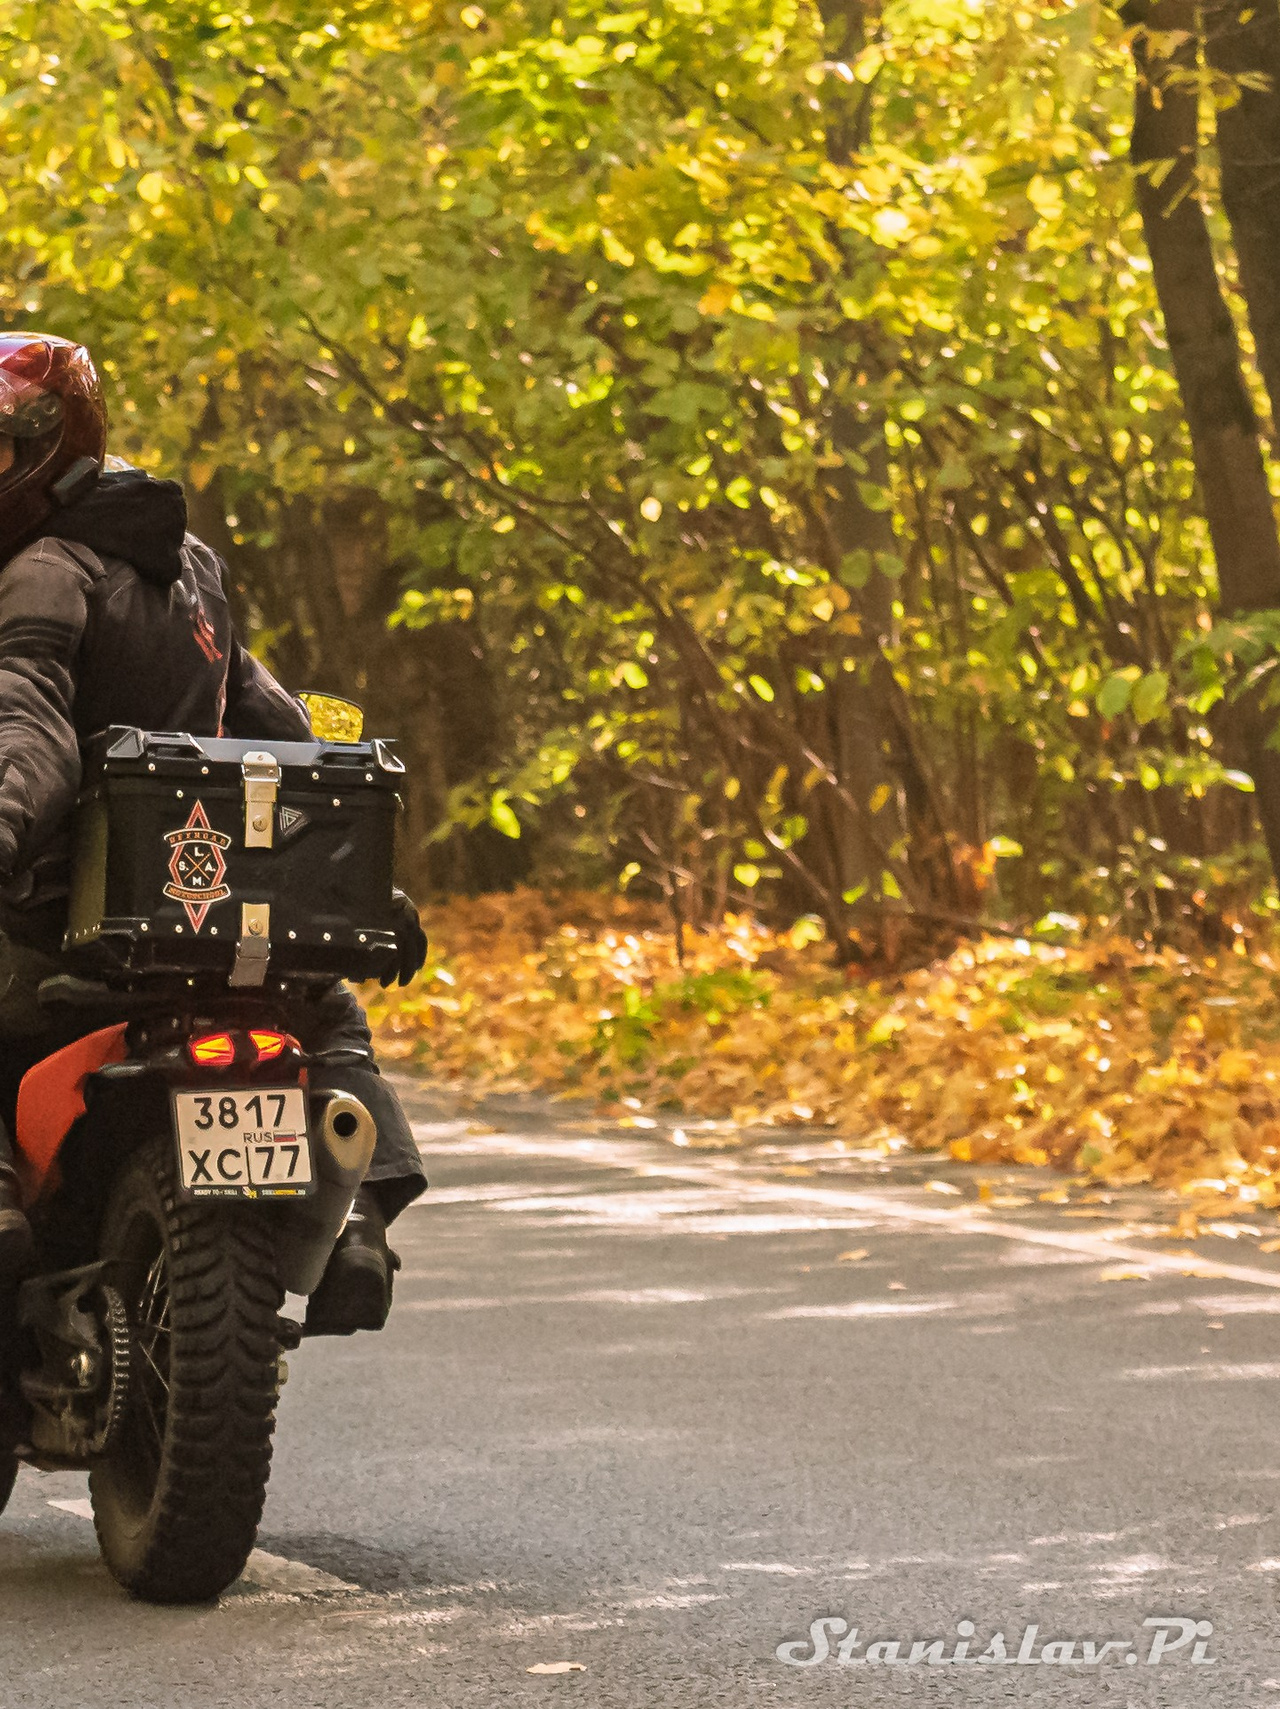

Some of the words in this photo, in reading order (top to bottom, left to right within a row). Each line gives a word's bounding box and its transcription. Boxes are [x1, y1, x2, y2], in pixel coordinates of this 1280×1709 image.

[193, 1094, 287, 1130] 3817
[243, 1132, 273, 1143] RUS
[188, 1148, 243, 1182] XC
[255, 1145, 300, 1179] 77
